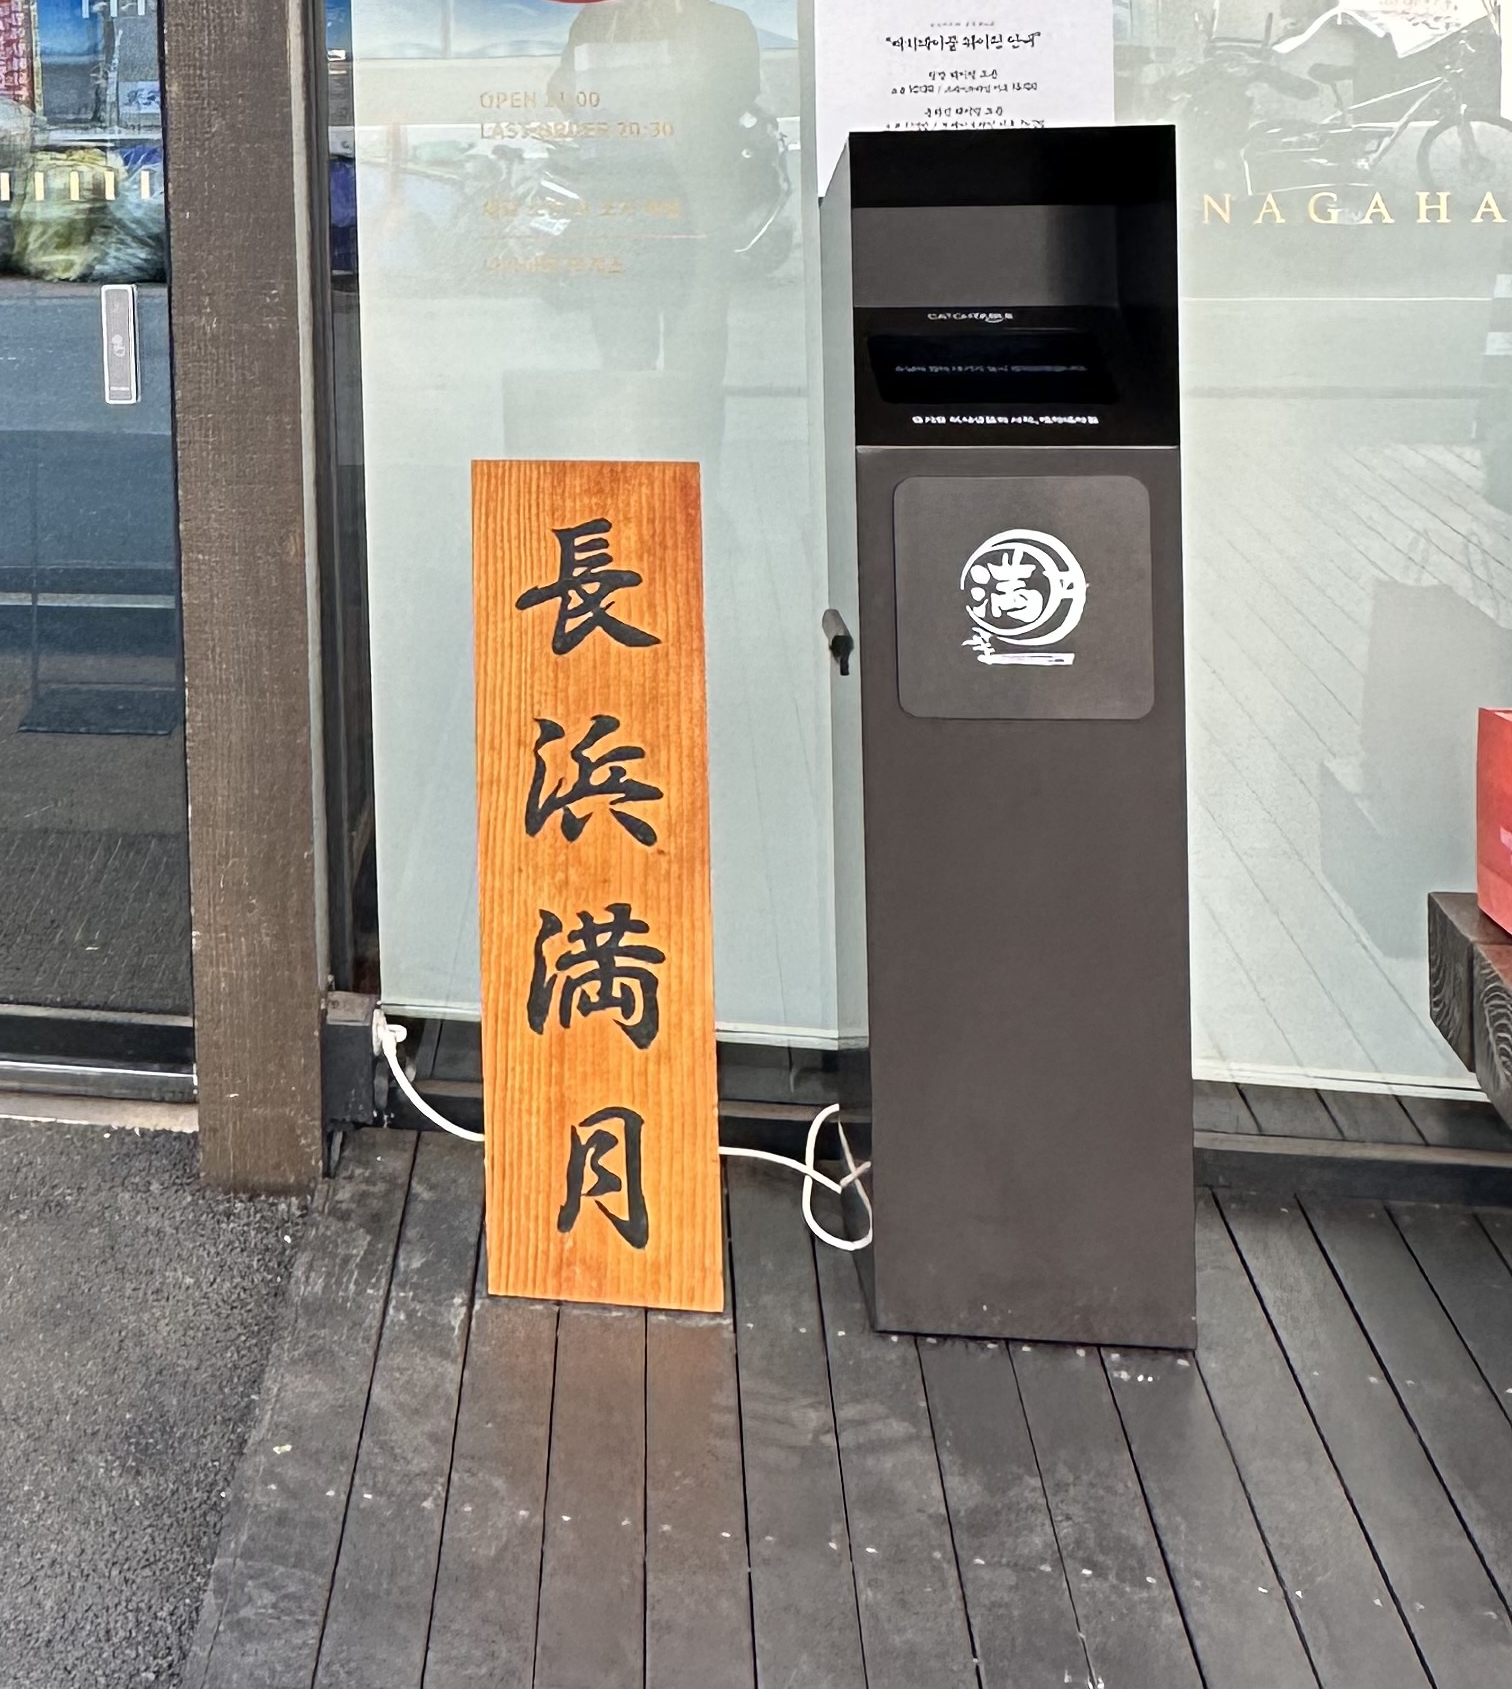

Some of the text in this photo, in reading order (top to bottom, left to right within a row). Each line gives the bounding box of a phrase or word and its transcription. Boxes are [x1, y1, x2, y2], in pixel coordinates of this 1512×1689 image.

[480, 91, 536, 110] OPEN
[1201, 190, 1508, 225] NAGAHA
[515, 517, 666, 1250] 長浜満月
